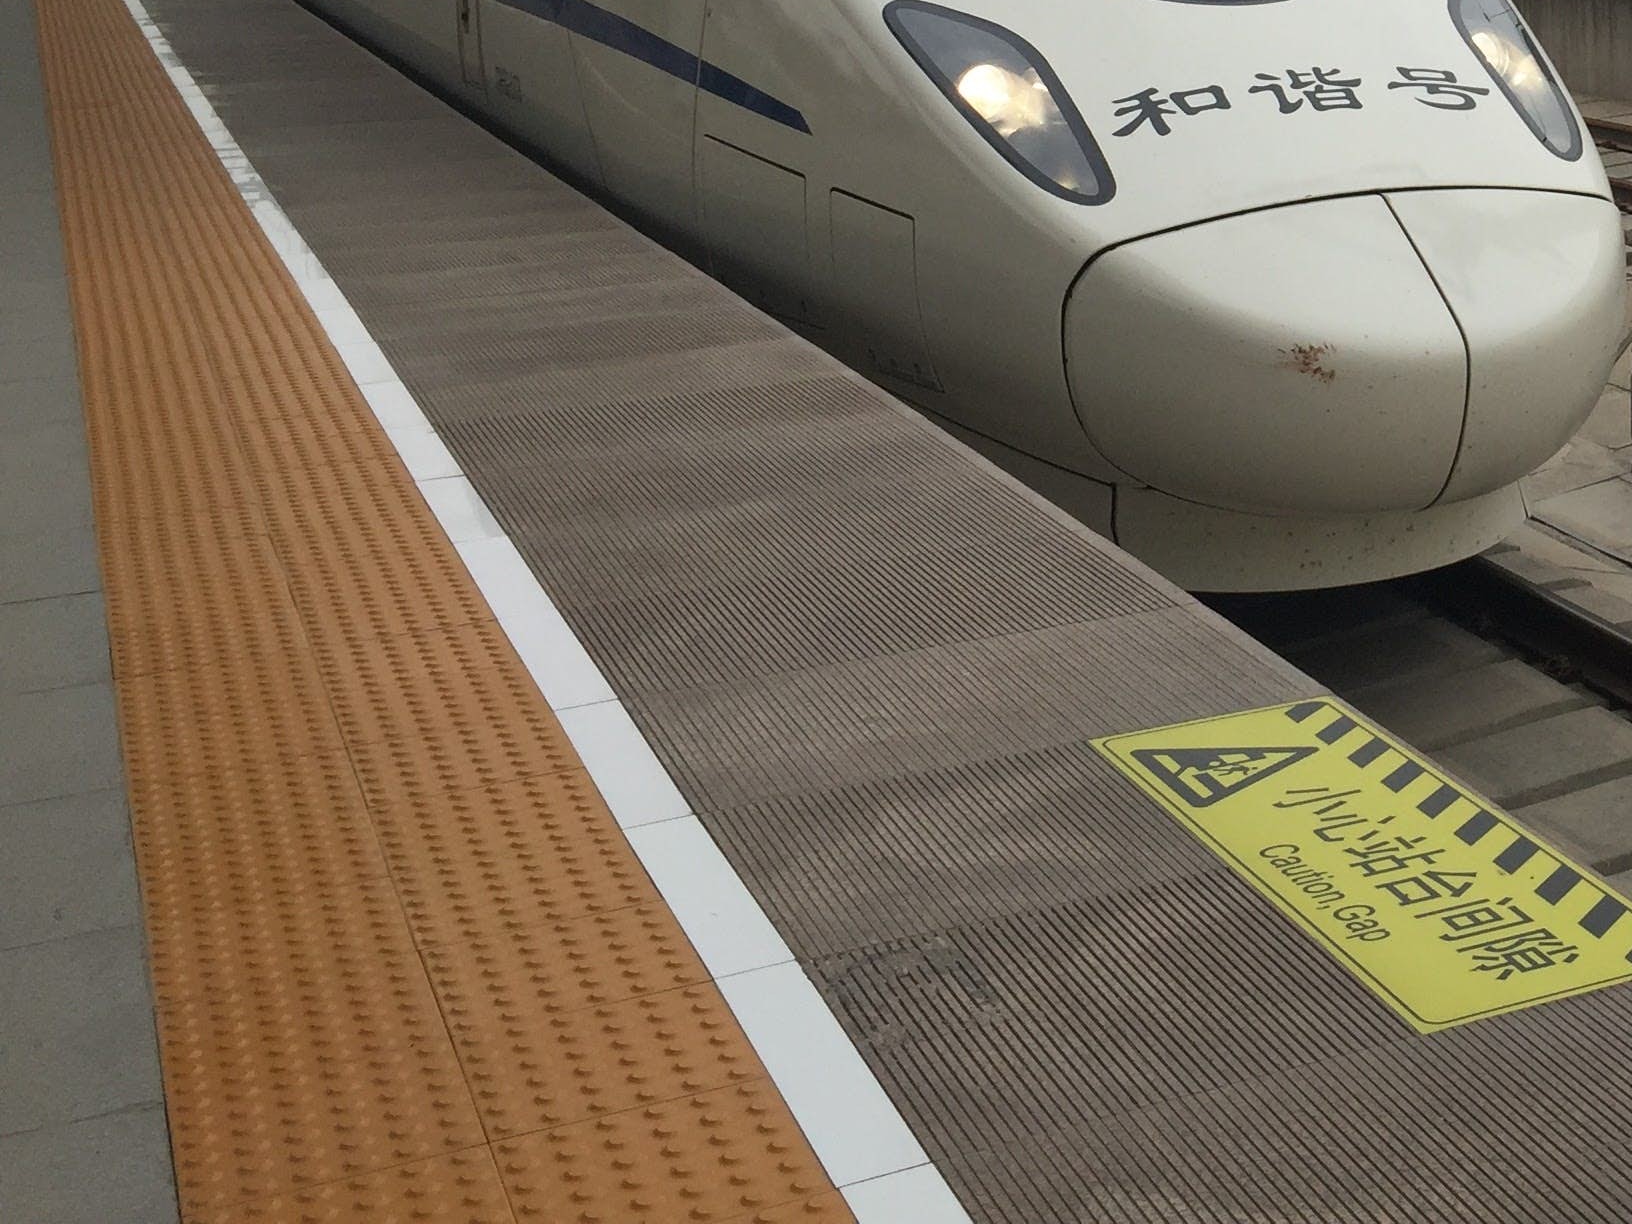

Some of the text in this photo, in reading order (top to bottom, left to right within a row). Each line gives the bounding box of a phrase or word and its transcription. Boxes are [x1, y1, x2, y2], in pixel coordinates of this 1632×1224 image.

[1112, 66, 1490, 137] 和谐号
[1273, 786, 1580, 981] 小心站台间隙
